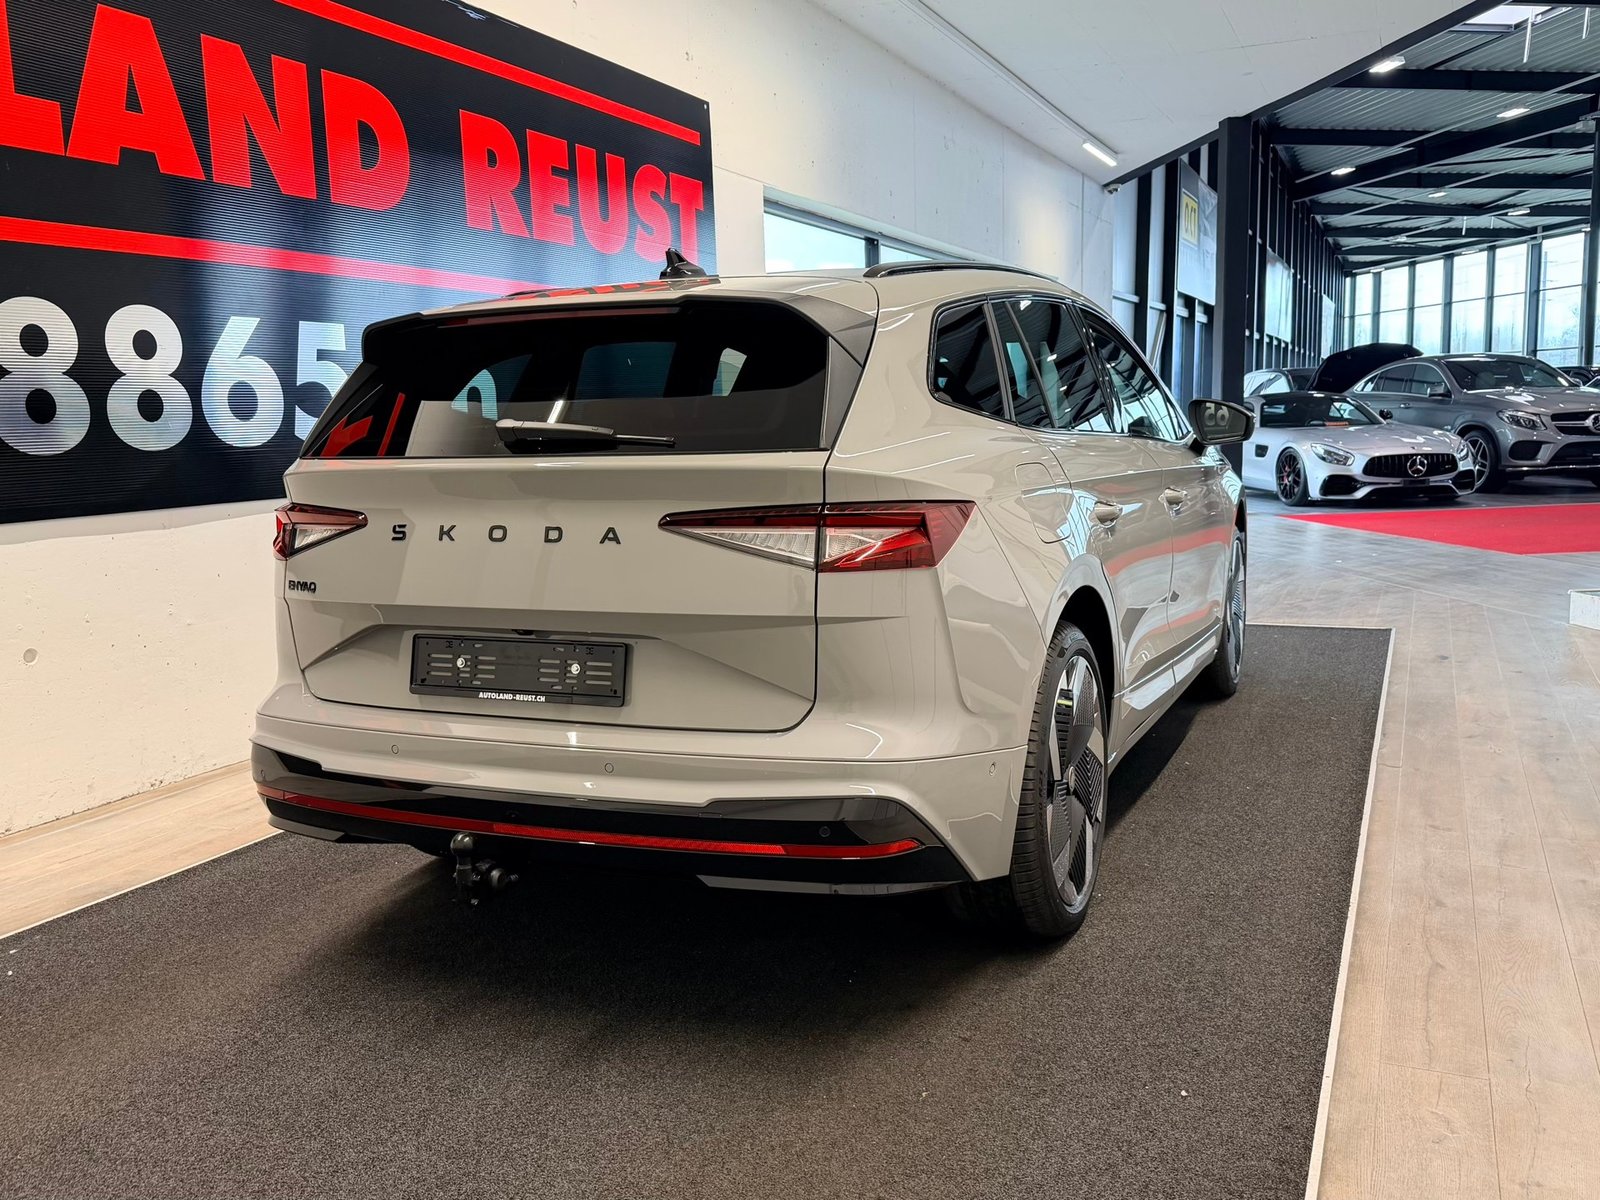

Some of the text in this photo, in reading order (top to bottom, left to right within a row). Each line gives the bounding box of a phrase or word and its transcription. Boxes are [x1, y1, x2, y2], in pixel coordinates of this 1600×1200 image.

[459, 108, 703, 263] REUST
[391, 523, 622, 545] SKODA
[288, 579, 317, 594] ENYAQ
